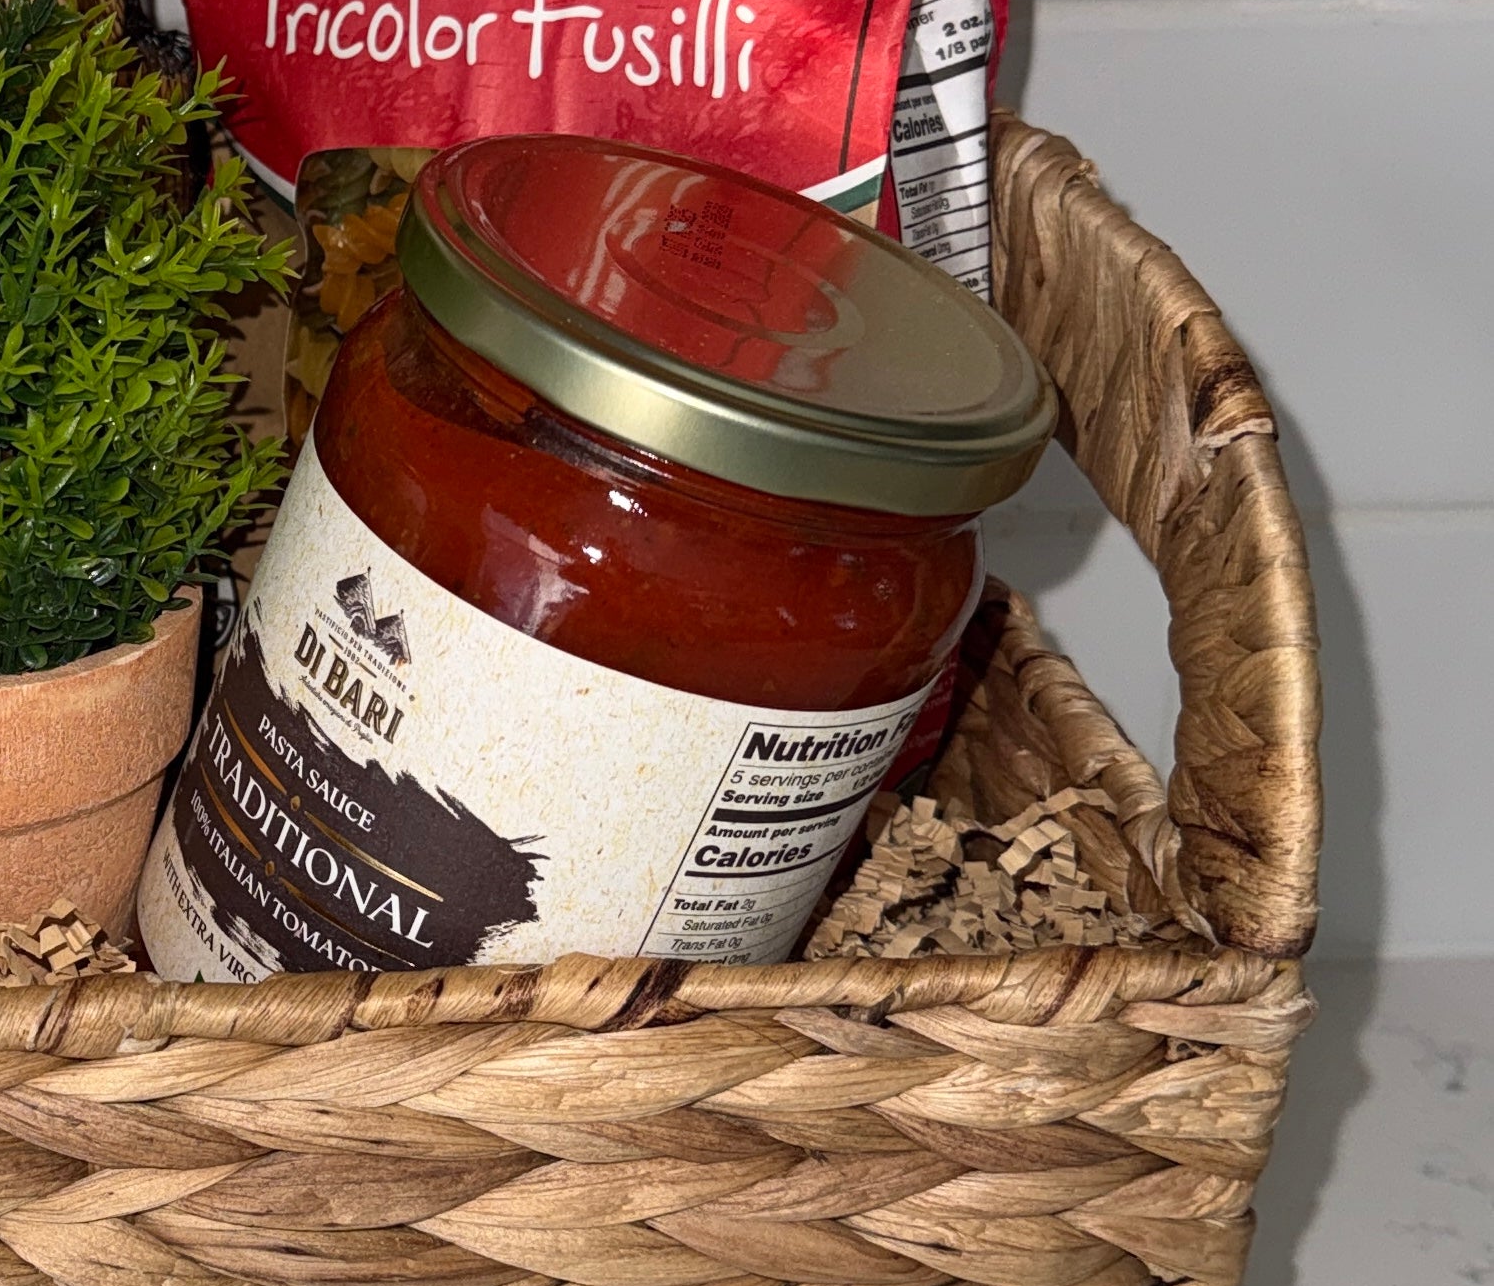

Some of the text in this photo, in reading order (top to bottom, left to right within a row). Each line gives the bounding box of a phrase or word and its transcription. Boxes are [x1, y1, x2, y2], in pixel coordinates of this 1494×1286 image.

[943, 21, 957, 38] 2
[936, 39, 967, 62] 1/8
[892, 113, 945, 144] Calories
[314, 608, 349, 641] PASTIFICIO
[349, 636, 363, 654] PER
[293, 621, 405, 745] DI BARI
[741, 726, 889, 763] Nutrition
[257, 714, 377, 833] PASTA SAUCE
[729, 769, 746, 784] 5
[748, 770, 822, 790] servings
[822, 767, 850, 788] per
[720, 788, 791, 807] Serving
[793, 789, 825, 805] size
[207, 712, 436, 950] TRADITIONAL
[705, 815, 841, 841] Amount per serving
[189, 788, 212, 837] 100%
[208, 826, 271, 908] ITALIAN
[694, 841, 814, 869] Calories
[162, 846, 181, 898] WITH
[177, 891, 215, 952] EXTRA
[672, 897, 713, 912] Total
[714, 899, 740, 912] Fat
[681, 918, 742, 932] Saturated
[670, 937, 706, 952] Trans
[707, 936, 728, 950] Fat
